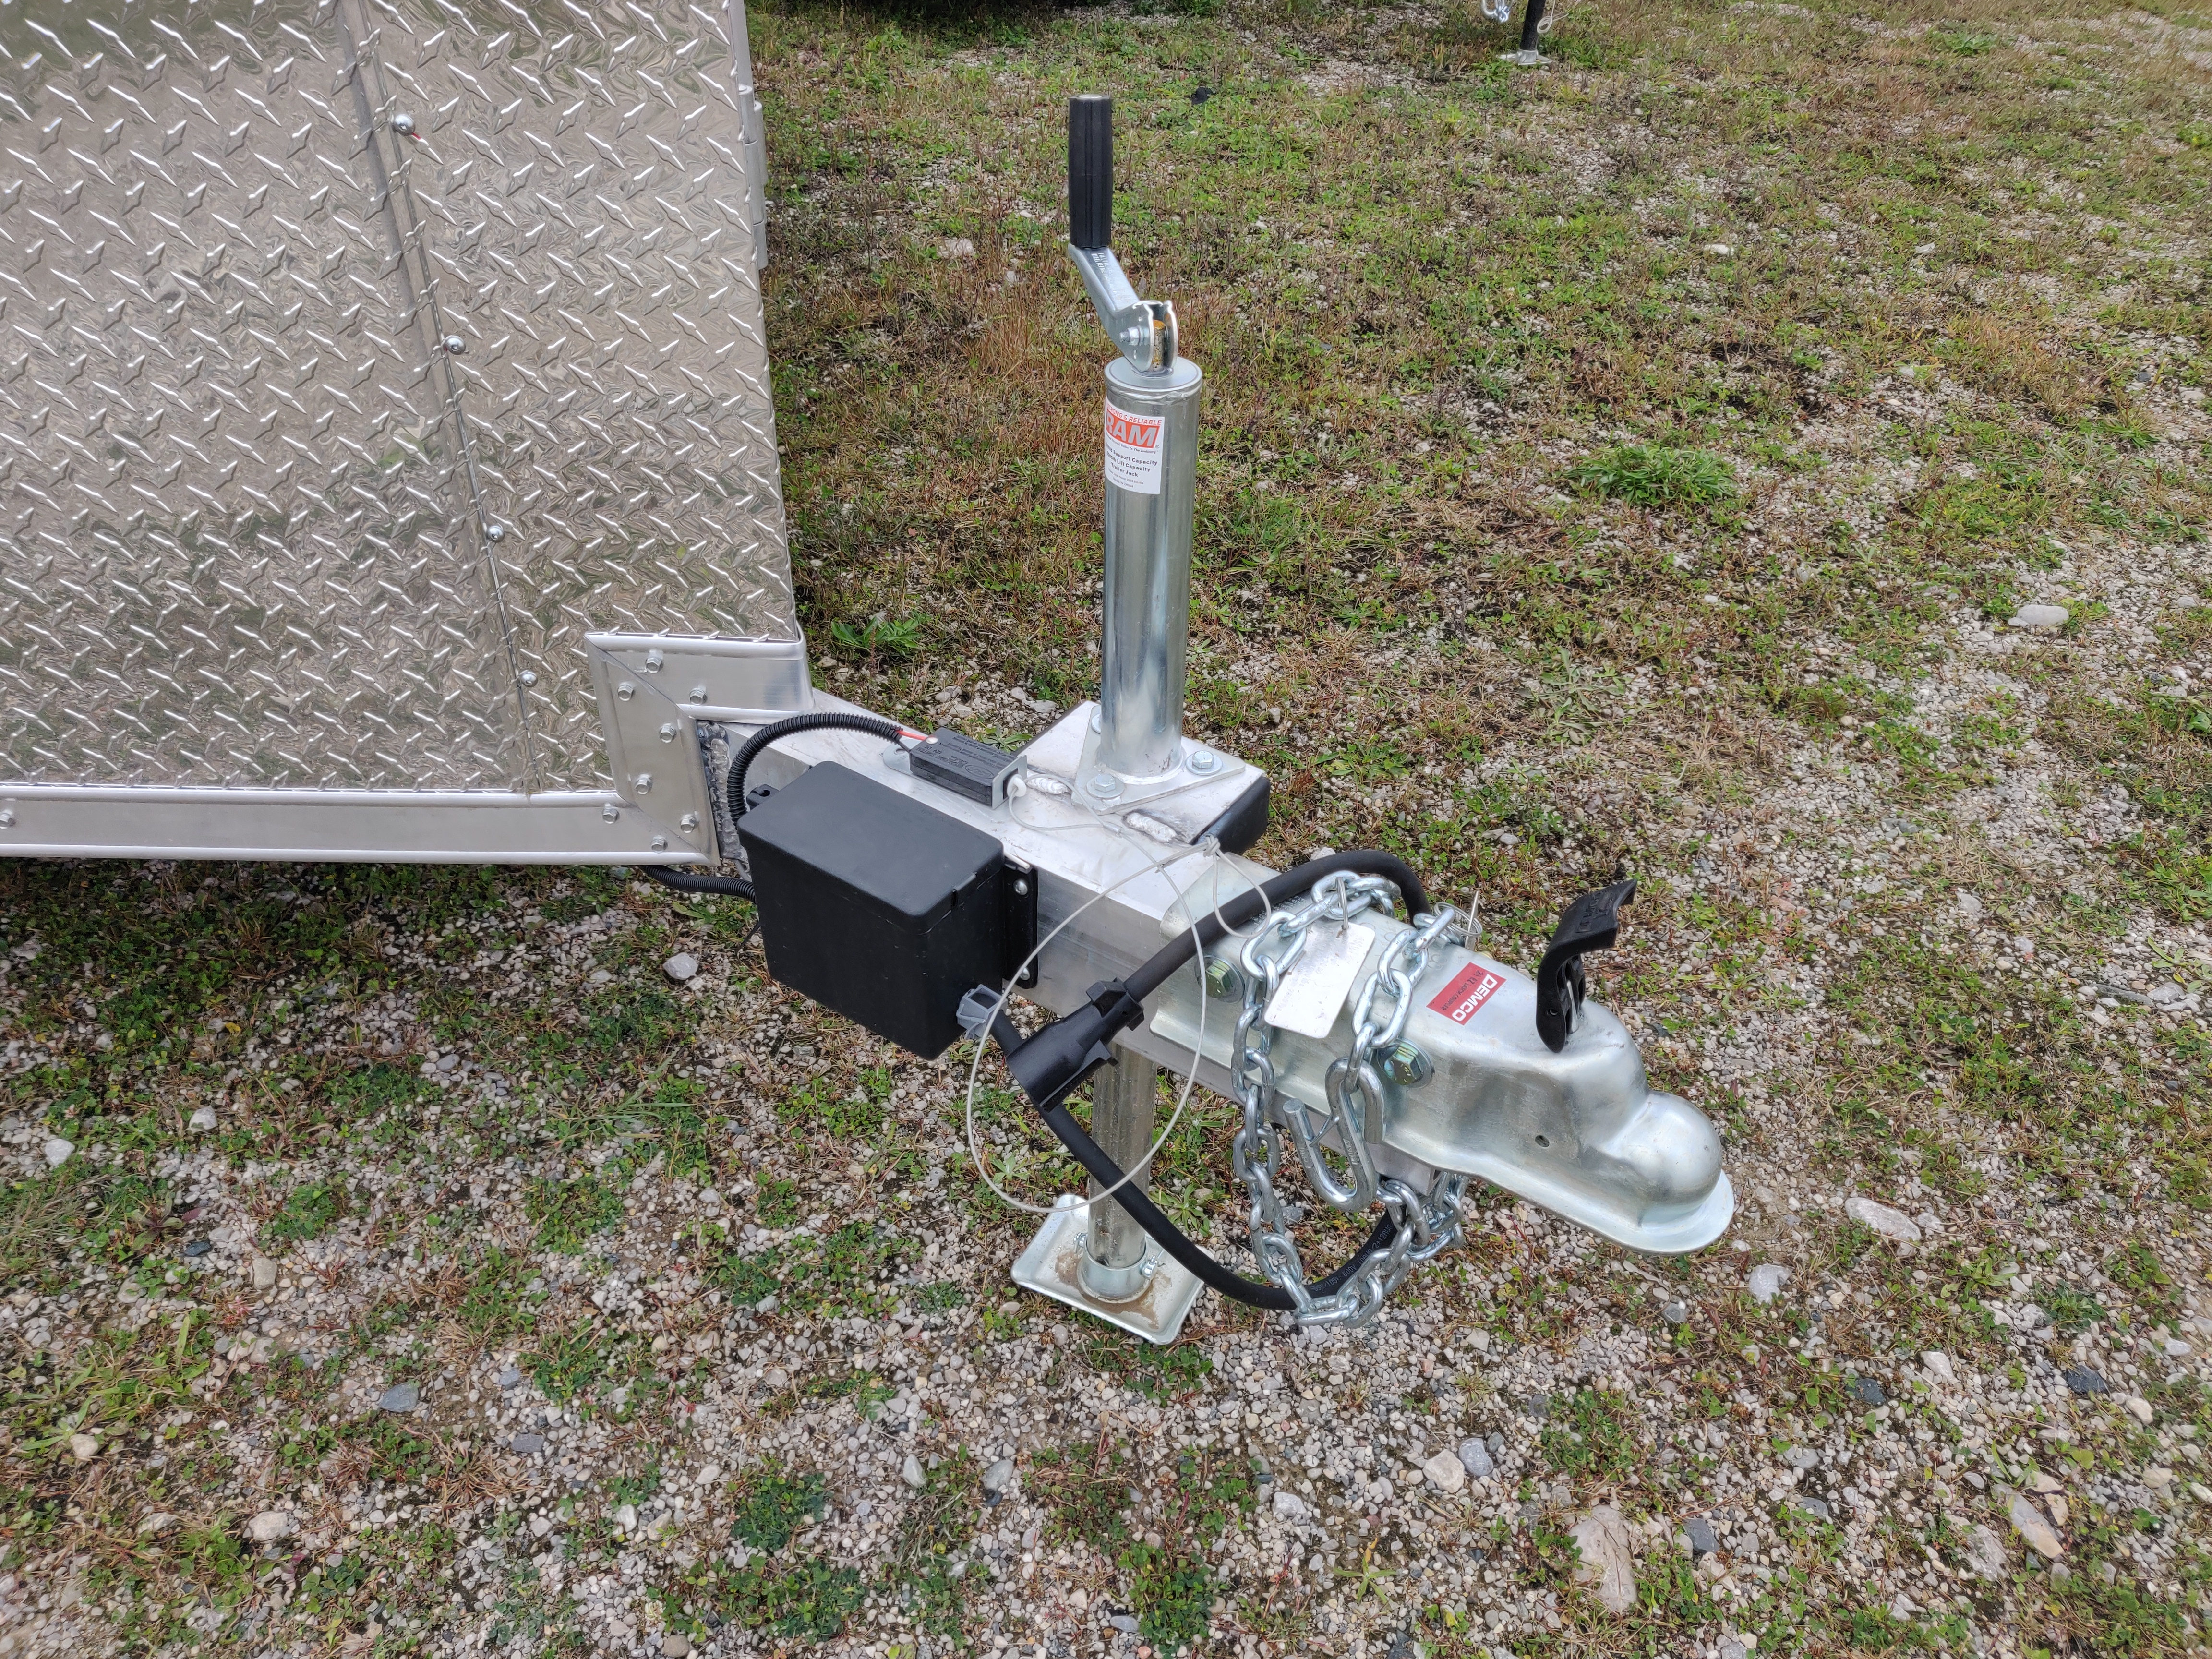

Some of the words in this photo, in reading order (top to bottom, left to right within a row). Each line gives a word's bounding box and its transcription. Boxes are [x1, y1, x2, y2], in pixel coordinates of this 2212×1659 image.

[1107, 403, 1123, 418] STRONG
[1129, 416, 1162, 425] RELIABLE
[1106, 411, 1157, 447] RAM
[1113, 449, 1130, 461] Support
[1111, 462, 1125, 473] Trailer
[1126, 463, 1150, 472] Capacity
[1452, 974, 1498, 1021] DEMCO
[1342, 1264, 1357, 1277] 600V
